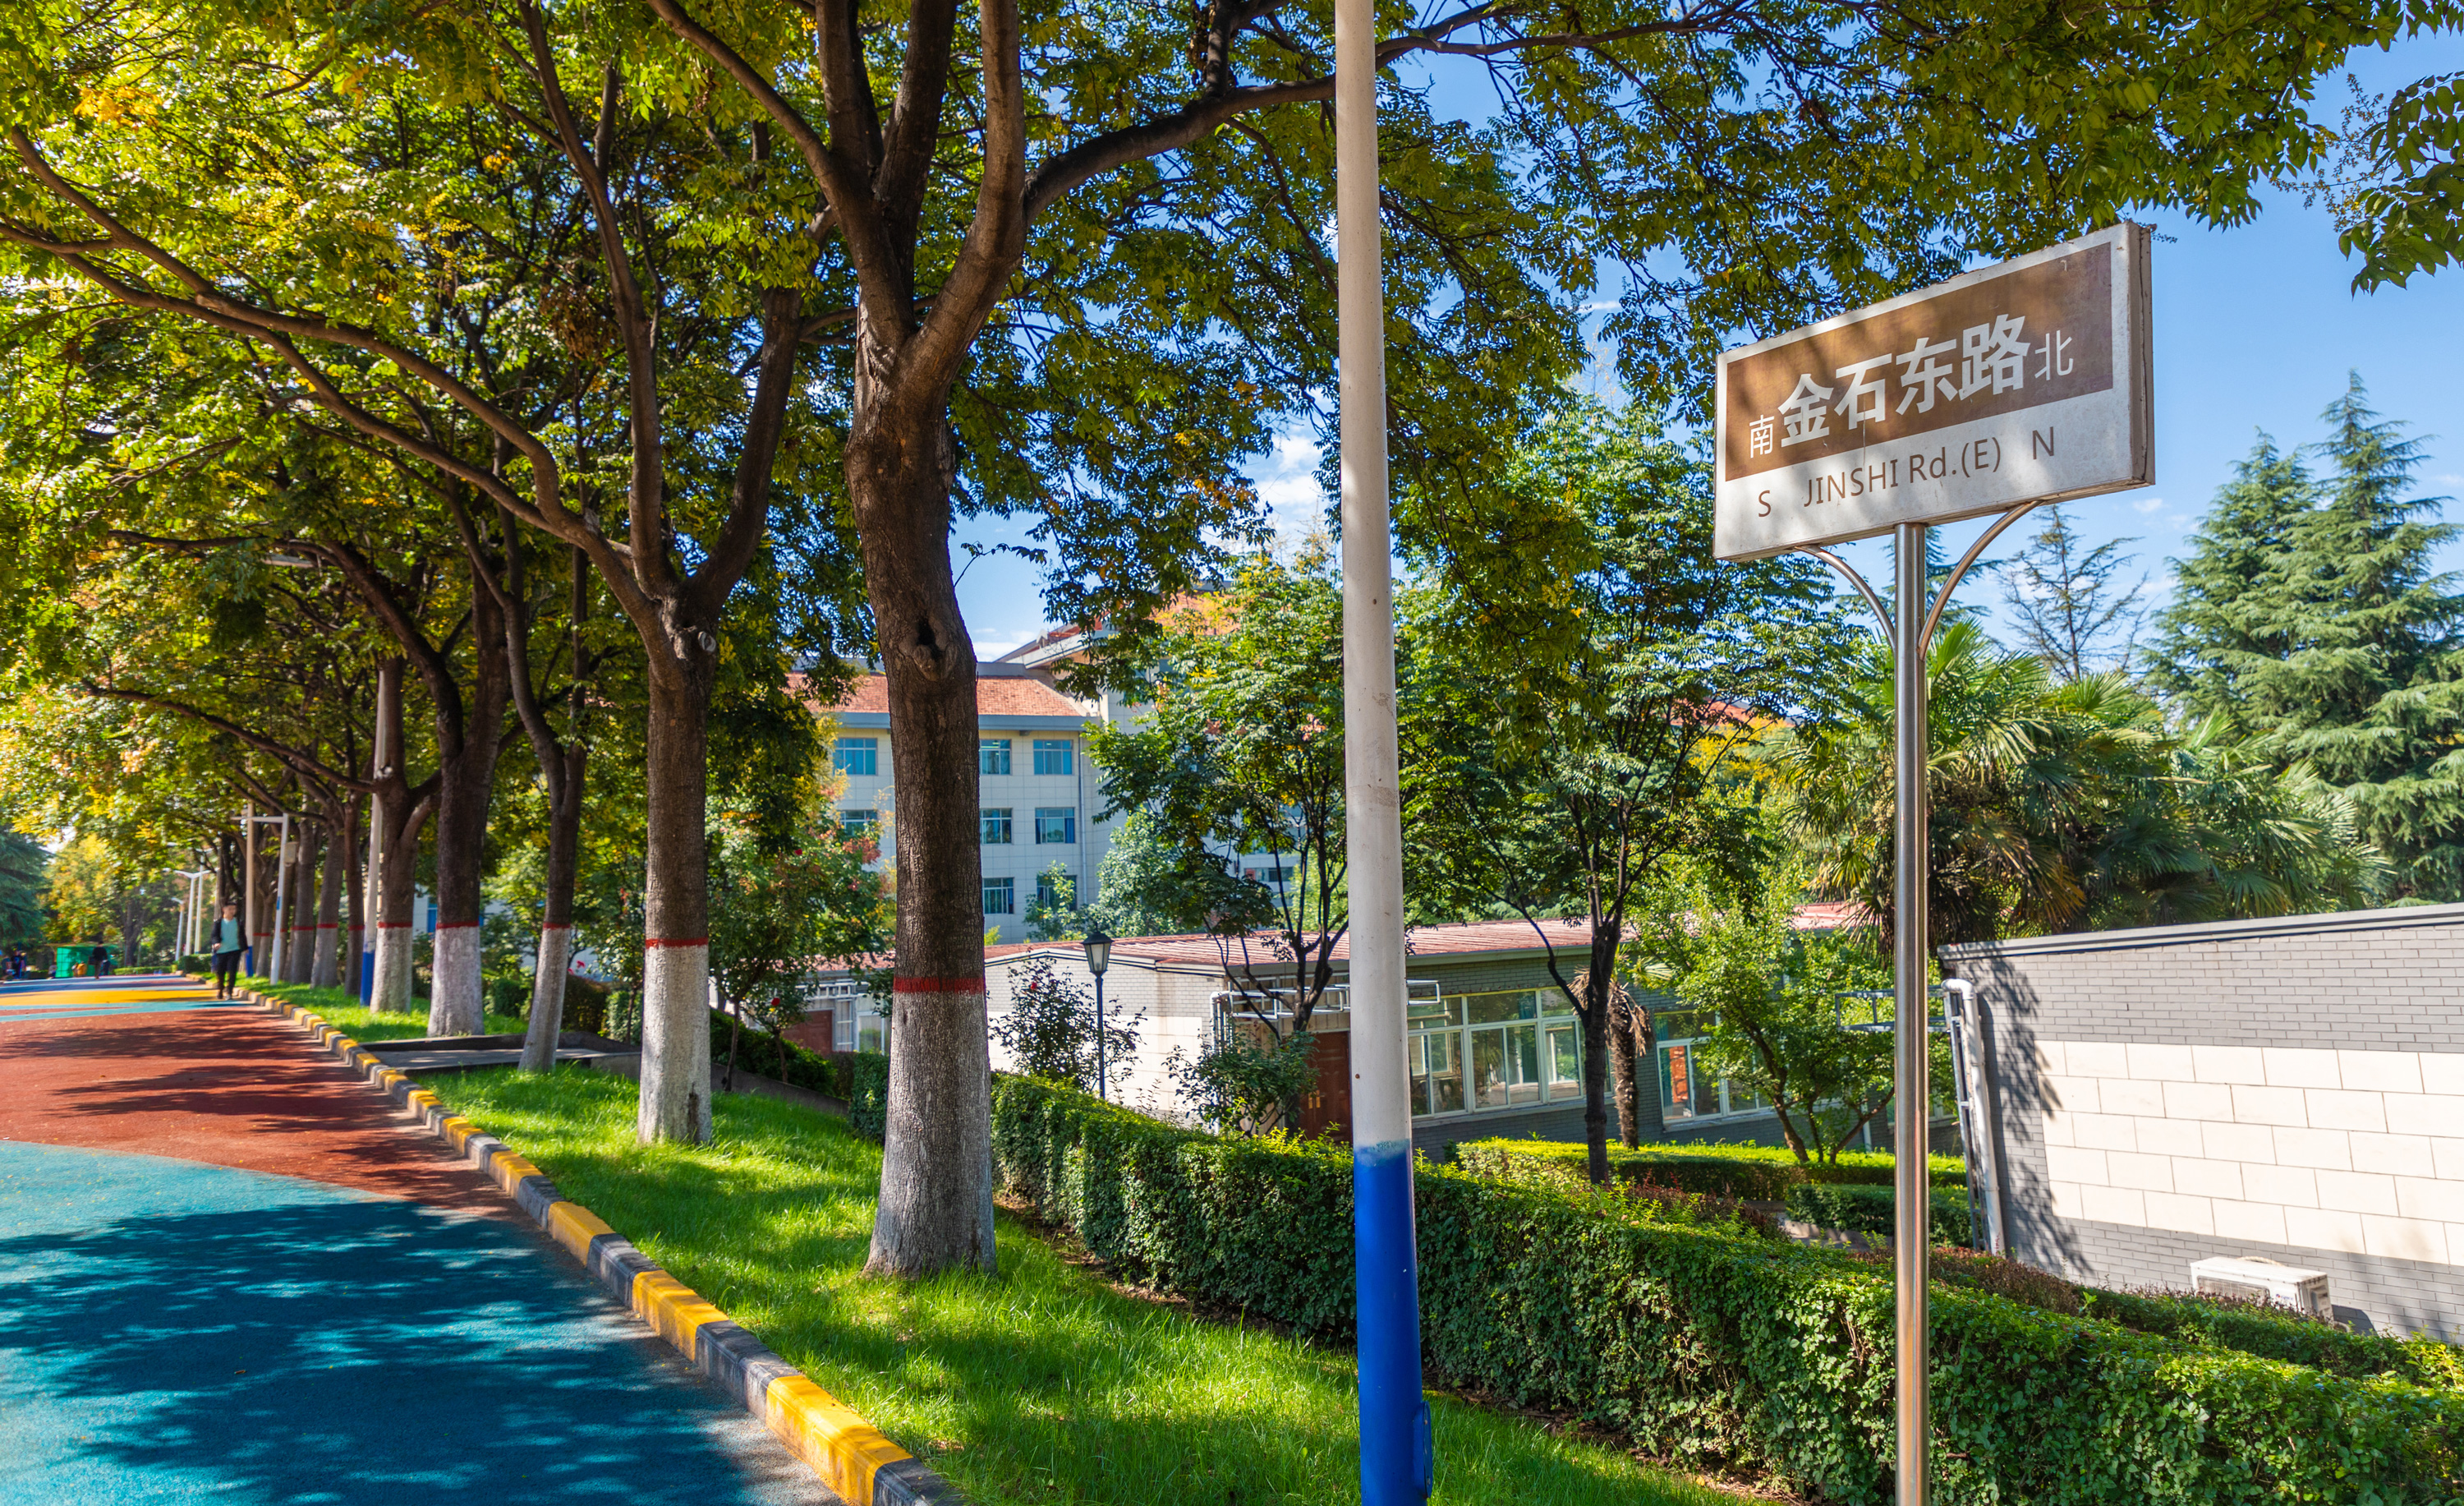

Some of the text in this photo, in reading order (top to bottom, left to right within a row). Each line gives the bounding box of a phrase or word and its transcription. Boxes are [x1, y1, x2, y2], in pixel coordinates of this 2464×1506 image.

[1749, 314, 2074, 458] 南 金石东路 北
[1758, 426, 2054, 518] S JINSHI Rd.(E) N
